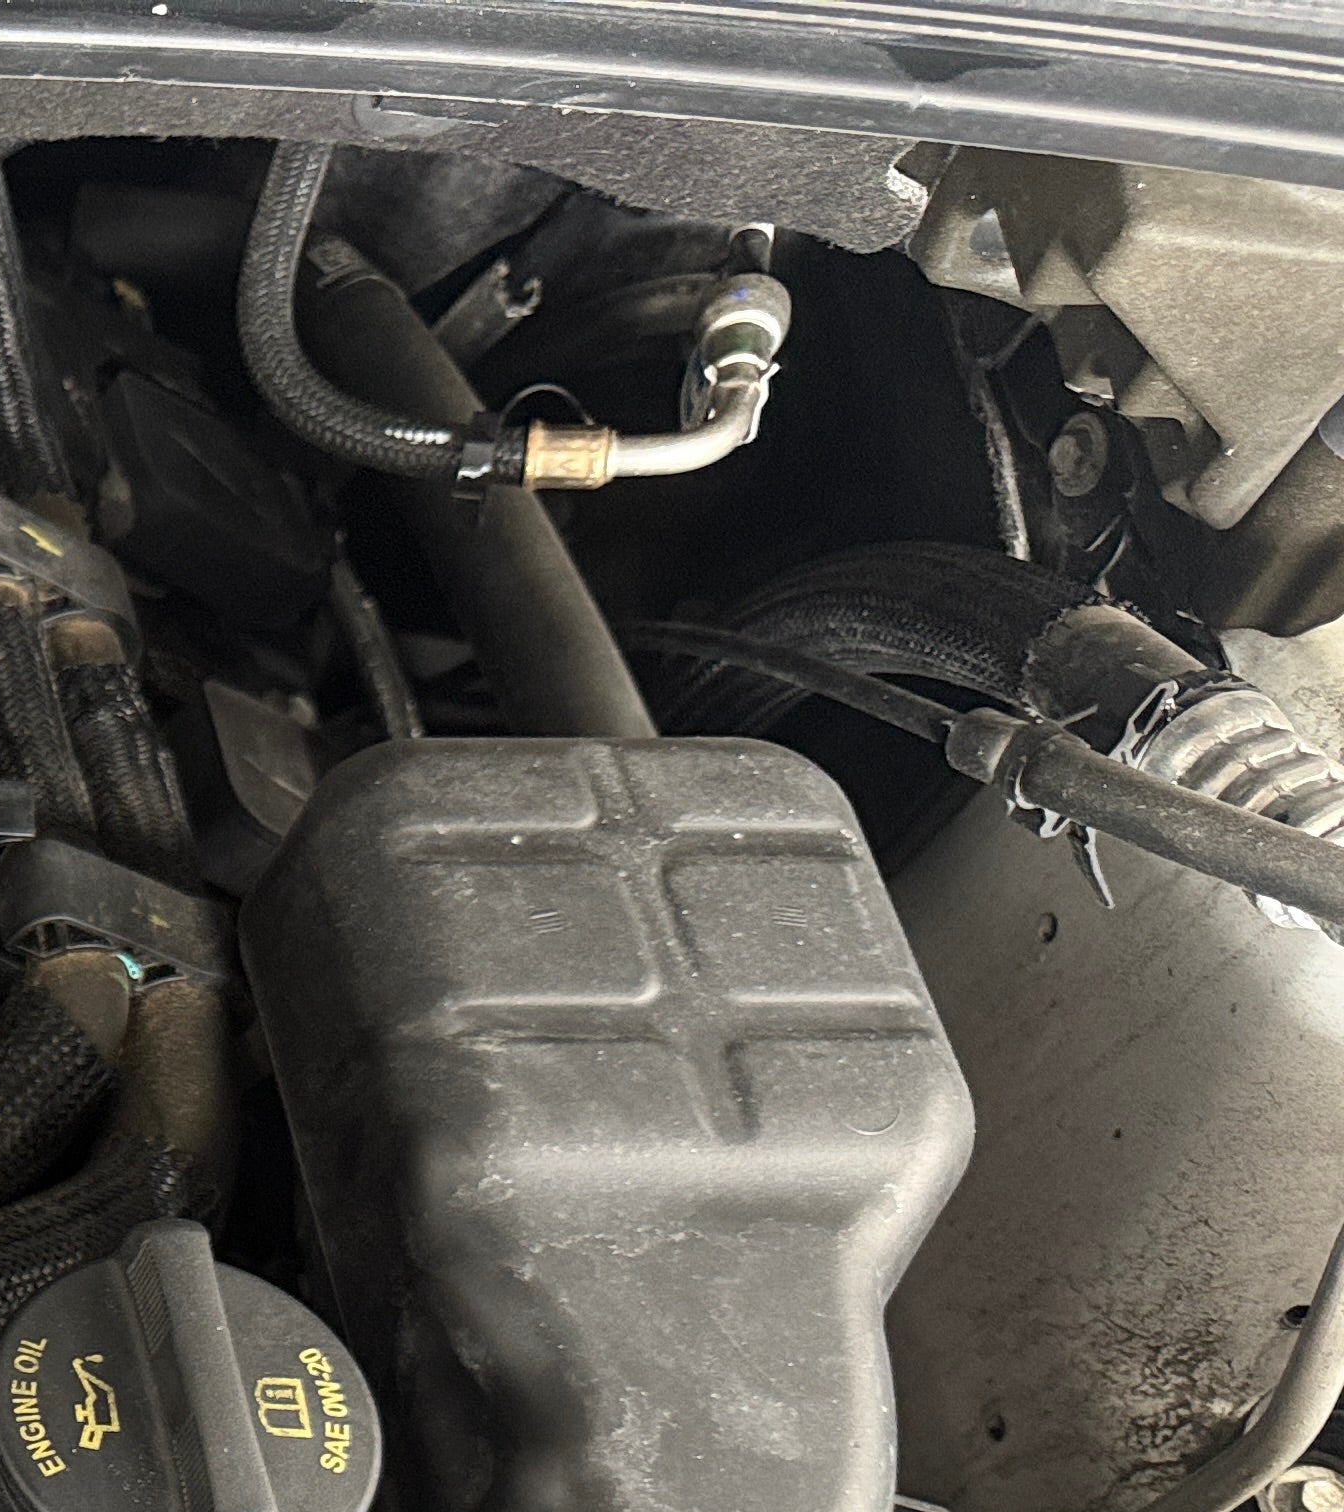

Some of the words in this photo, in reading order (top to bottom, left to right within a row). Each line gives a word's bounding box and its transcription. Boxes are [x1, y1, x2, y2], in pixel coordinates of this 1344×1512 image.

[14, 1338, 48, 1374] OIL
[299, 1347, 348, 1418] 0W-20
[11, 1379, 66, 1477] ENGINE
[320, 1421, 350, 1474] SAE
